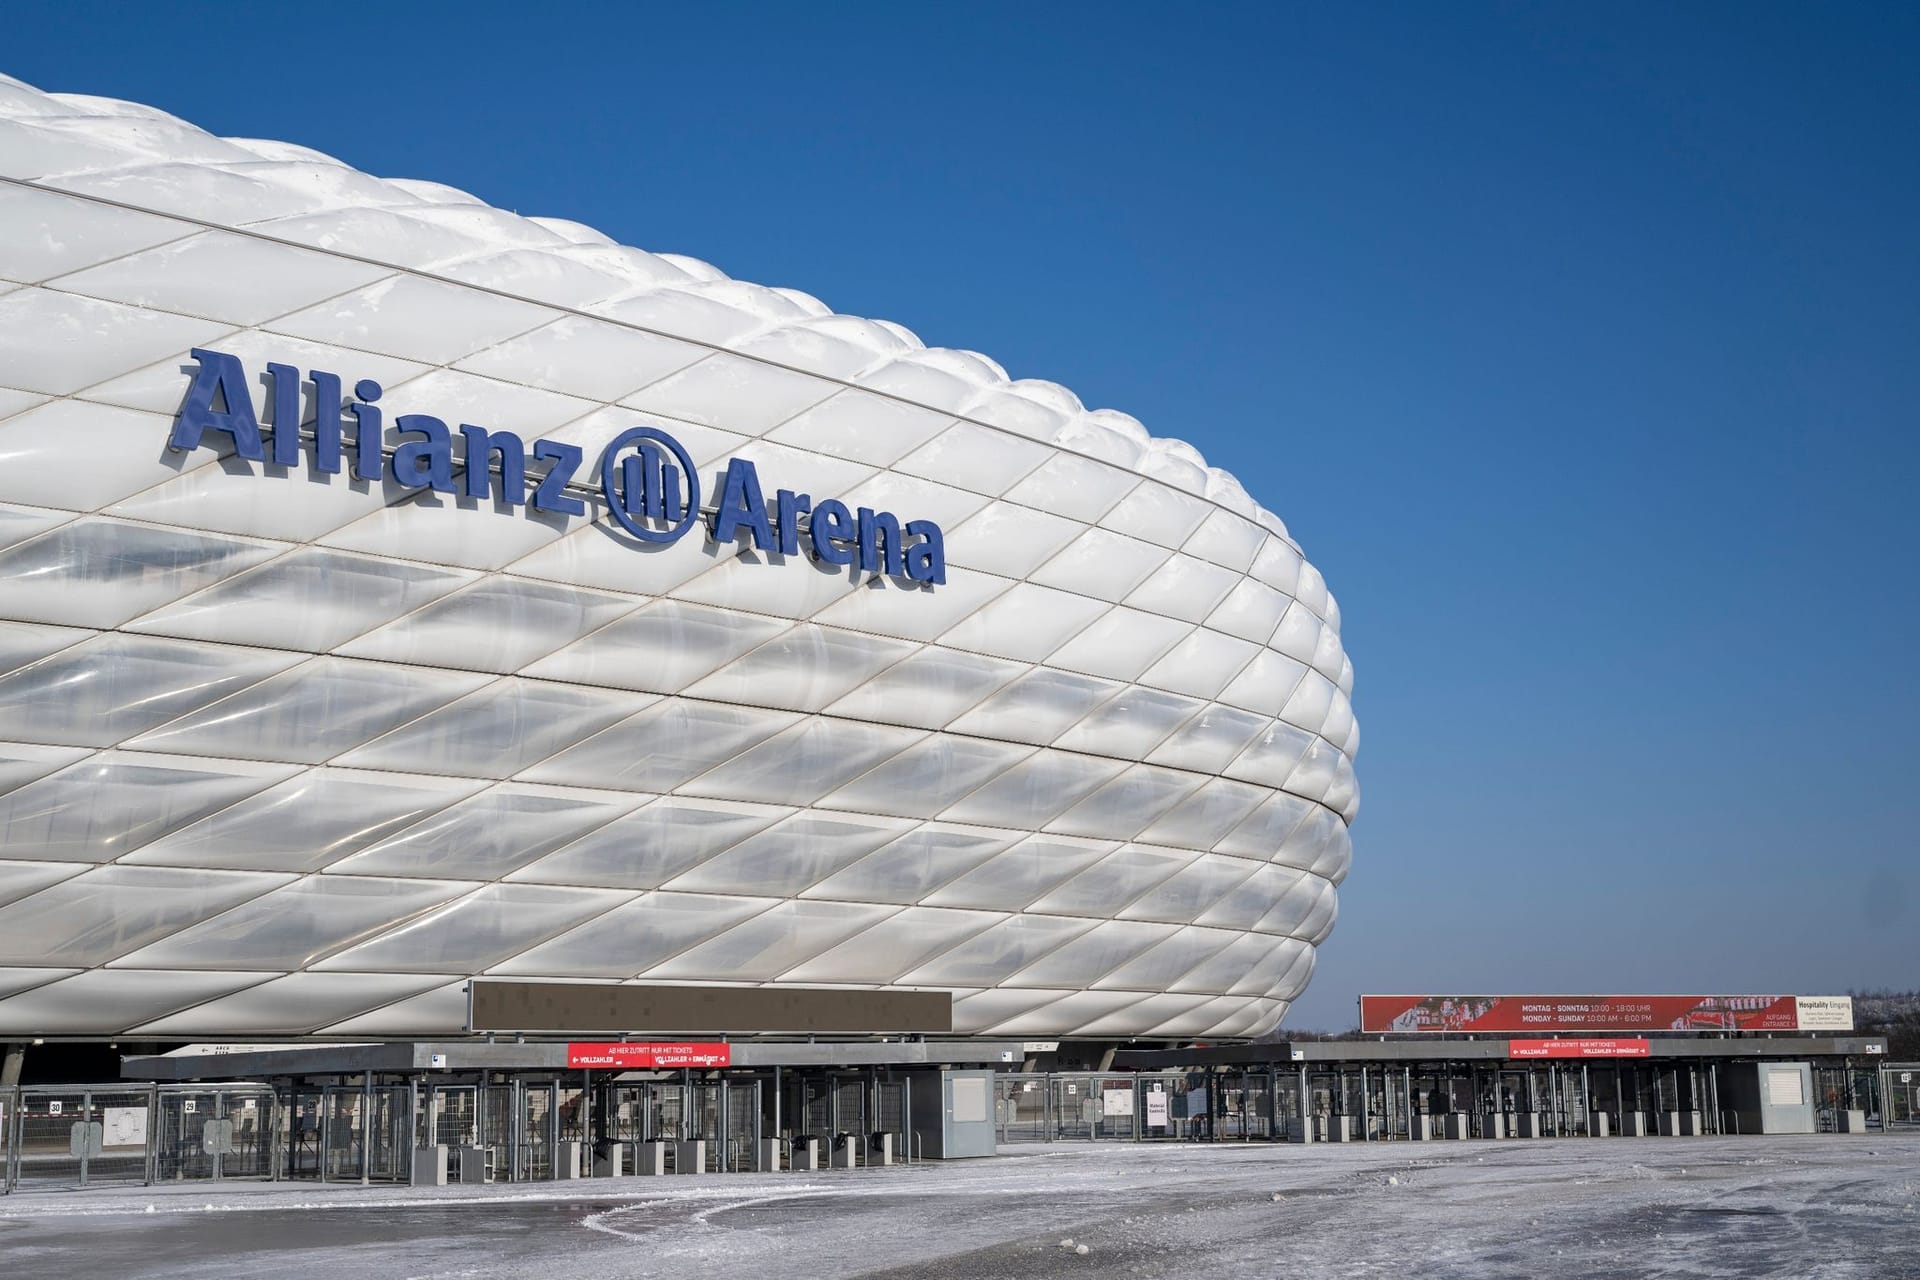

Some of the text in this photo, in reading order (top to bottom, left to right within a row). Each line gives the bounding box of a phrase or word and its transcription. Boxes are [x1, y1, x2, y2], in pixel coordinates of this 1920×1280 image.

[171, 347, 946, 586] Allianz Arena
[1798, 1001, 1828, 1009] Hospitality
[51, 1104, 60, 1112] 30
[186, 1103, 193, 1111] 29
